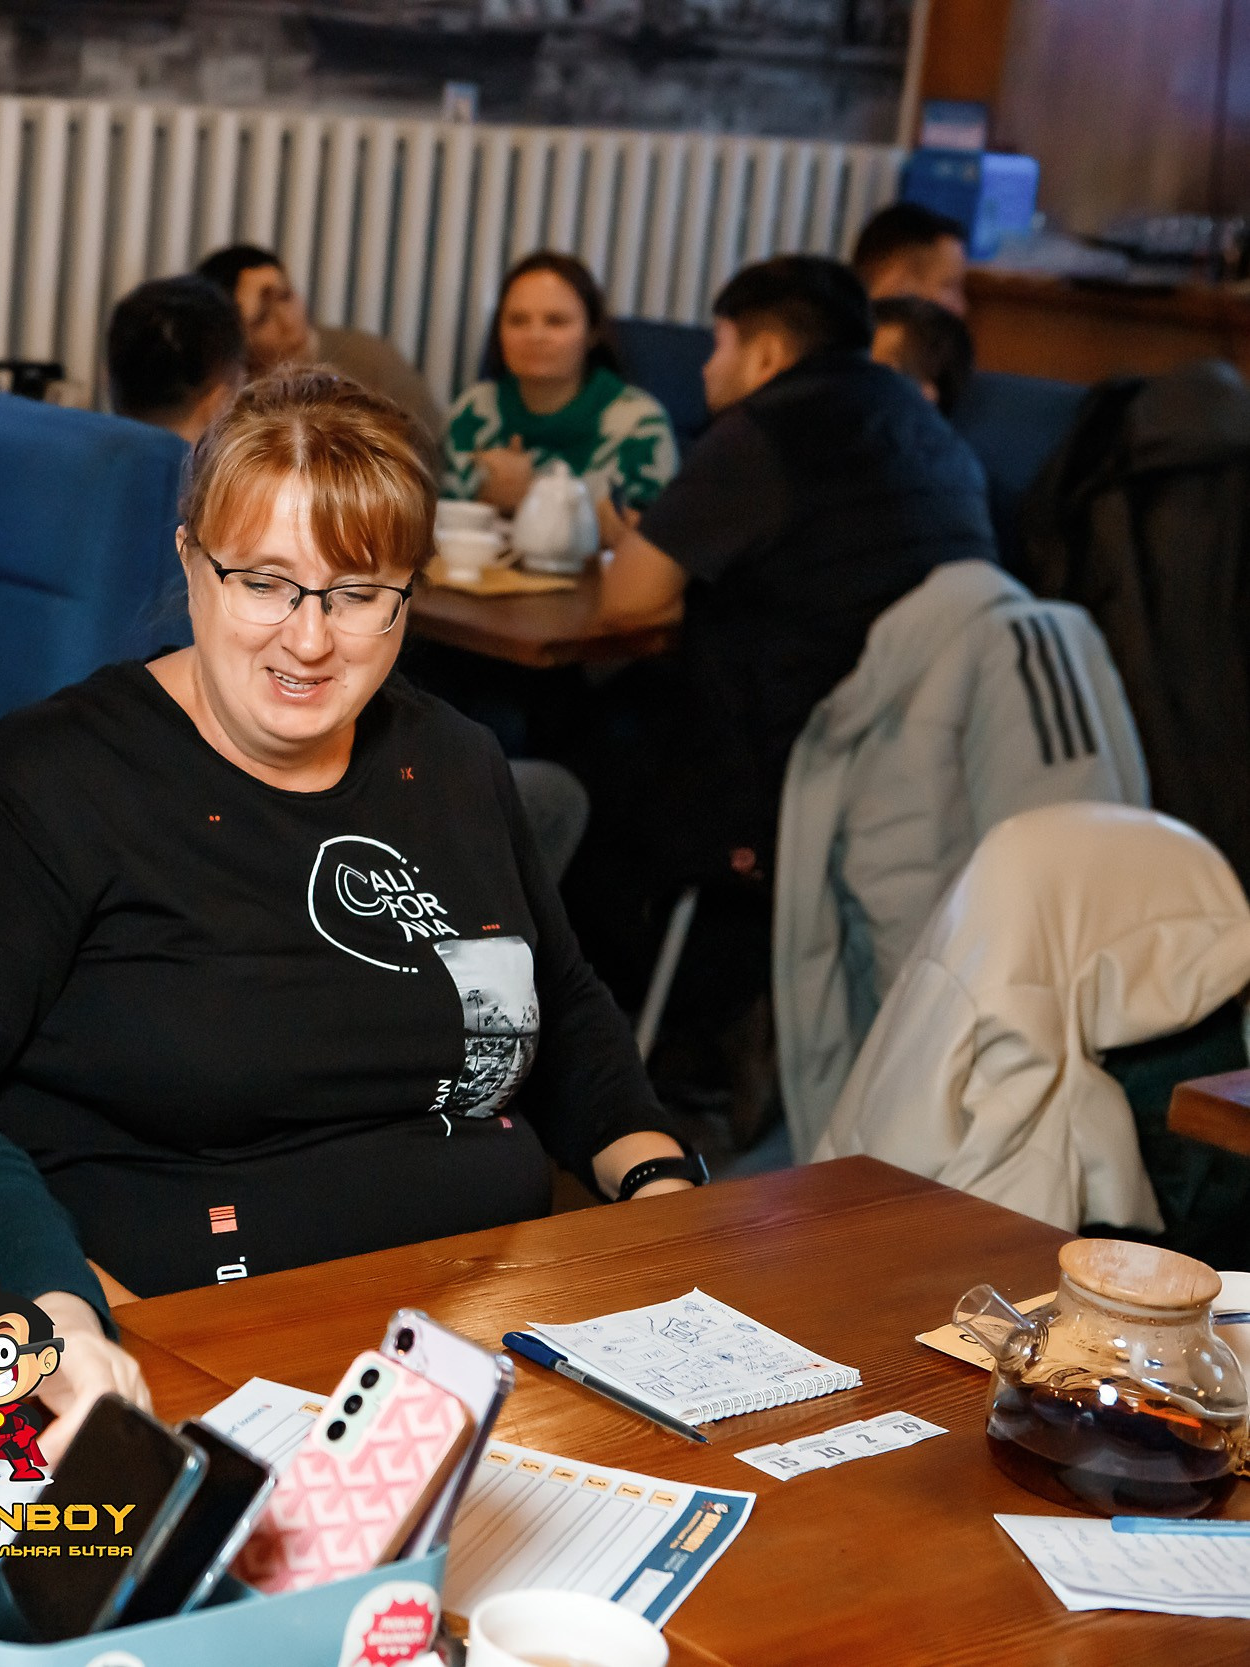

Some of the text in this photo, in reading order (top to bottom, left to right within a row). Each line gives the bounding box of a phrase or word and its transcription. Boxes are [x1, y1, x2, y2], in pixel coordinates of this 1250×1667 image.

[892, 1420, 922, 1434] 29
[855, 1433, 878, 1445] 2
[813, 1446, 846, 1459] 10
[769, 1456, 800, 1471] 15
